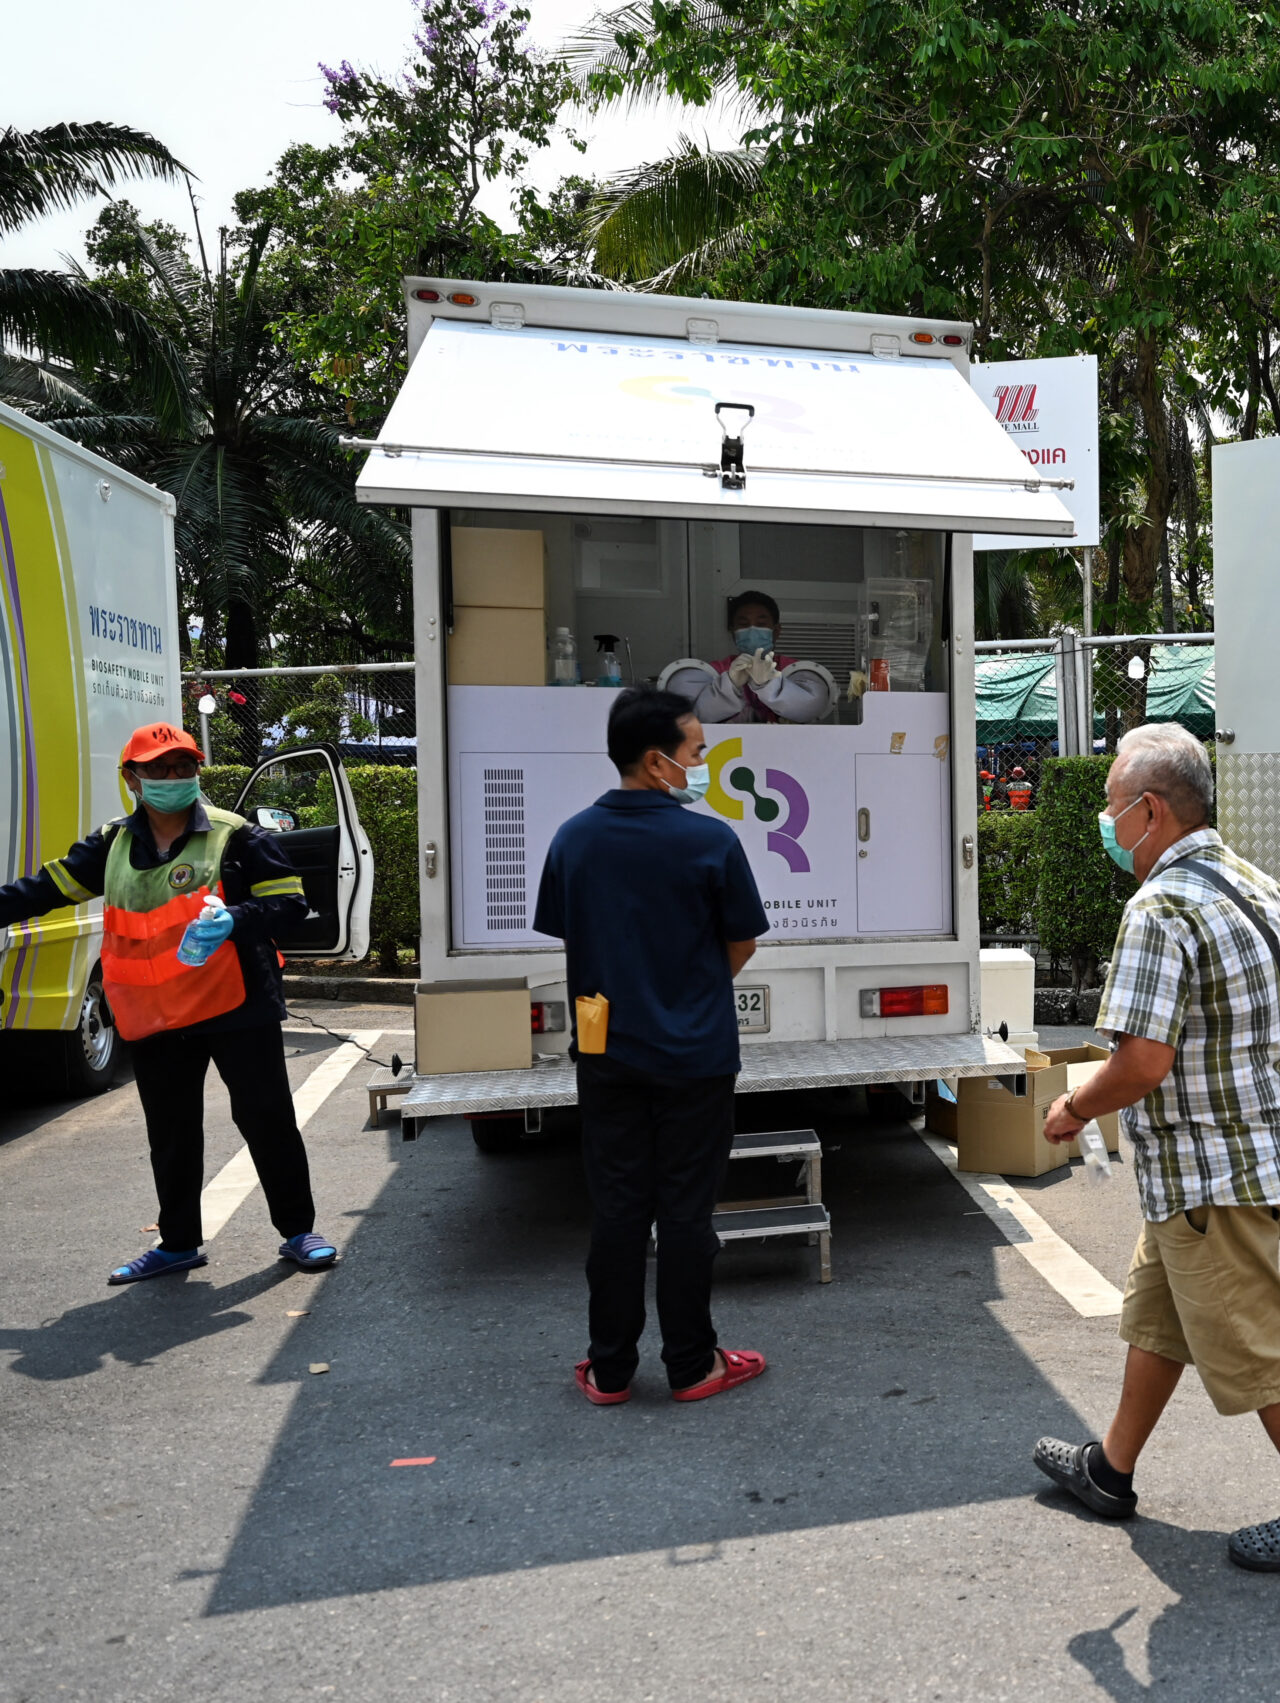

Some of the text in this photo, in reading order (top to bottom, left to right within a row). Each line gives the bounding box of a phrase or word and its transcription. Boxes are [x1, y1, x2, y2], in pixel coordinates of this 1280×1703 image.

[1013, 422, 1039, 431] MALL
[89, 605, 162, 654] พระราชทาน
[92, 659, 164, 686] BIOSAFETY MOBILE UNIT
[764, 899, 837, 910] OBILE UNIT
